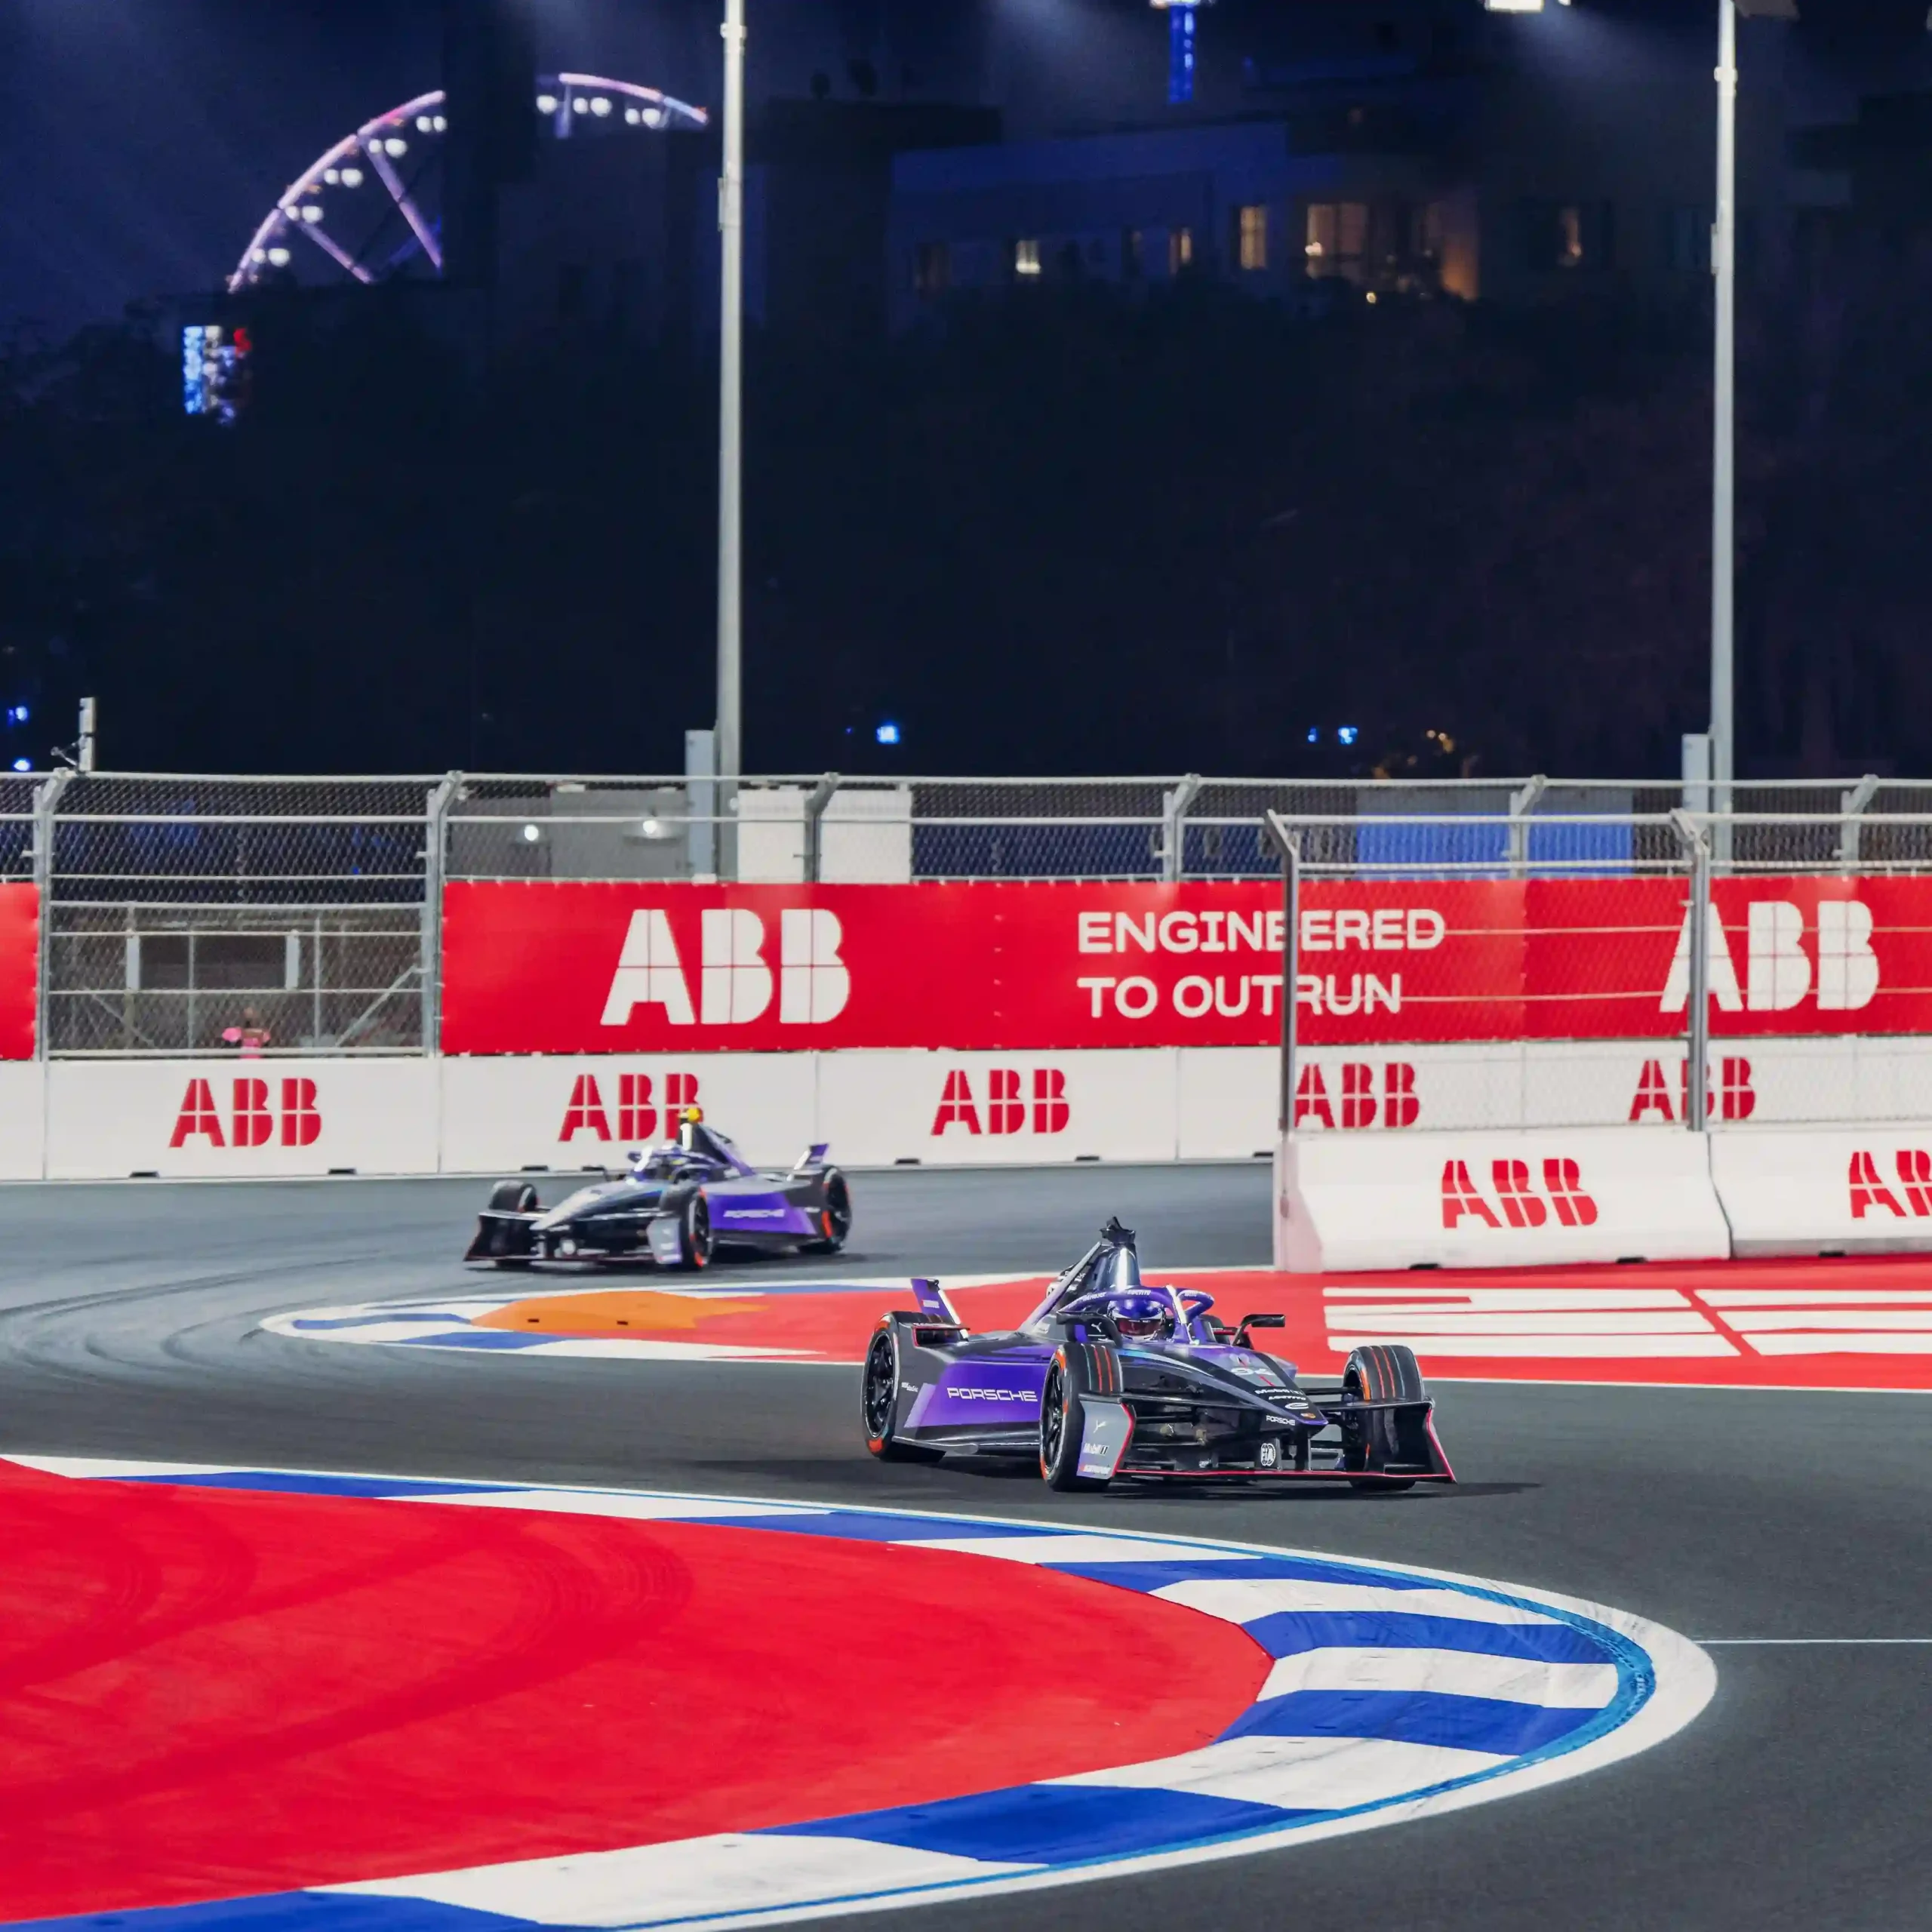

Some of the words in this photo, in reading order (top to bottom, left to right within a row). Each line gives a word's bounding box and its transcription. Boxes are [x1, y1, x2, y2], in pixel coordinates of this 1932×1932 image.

[1078, 909, 1444, 953] ENGINEERED
[1660, 900, 1879, 1012] ABB
[601, 909, 851, 1026] ABB
[1077, 977, 1158, 1018] TO
[1172, 974, 1401, 1017] OUTRUN
[169, 1078, 321, 1147] ABB
[558, 1073, 704, 1142] ABB
[932, 1069, 1072, 1136] ABB
[1294, 1063, 1420, 1128] ABB
[1442, 1158, 1598, 1229] ABB
[946, 1387, 1038, 1401] PORSCHE
[1266, 1415, 1296, 1426] PORSCHE
